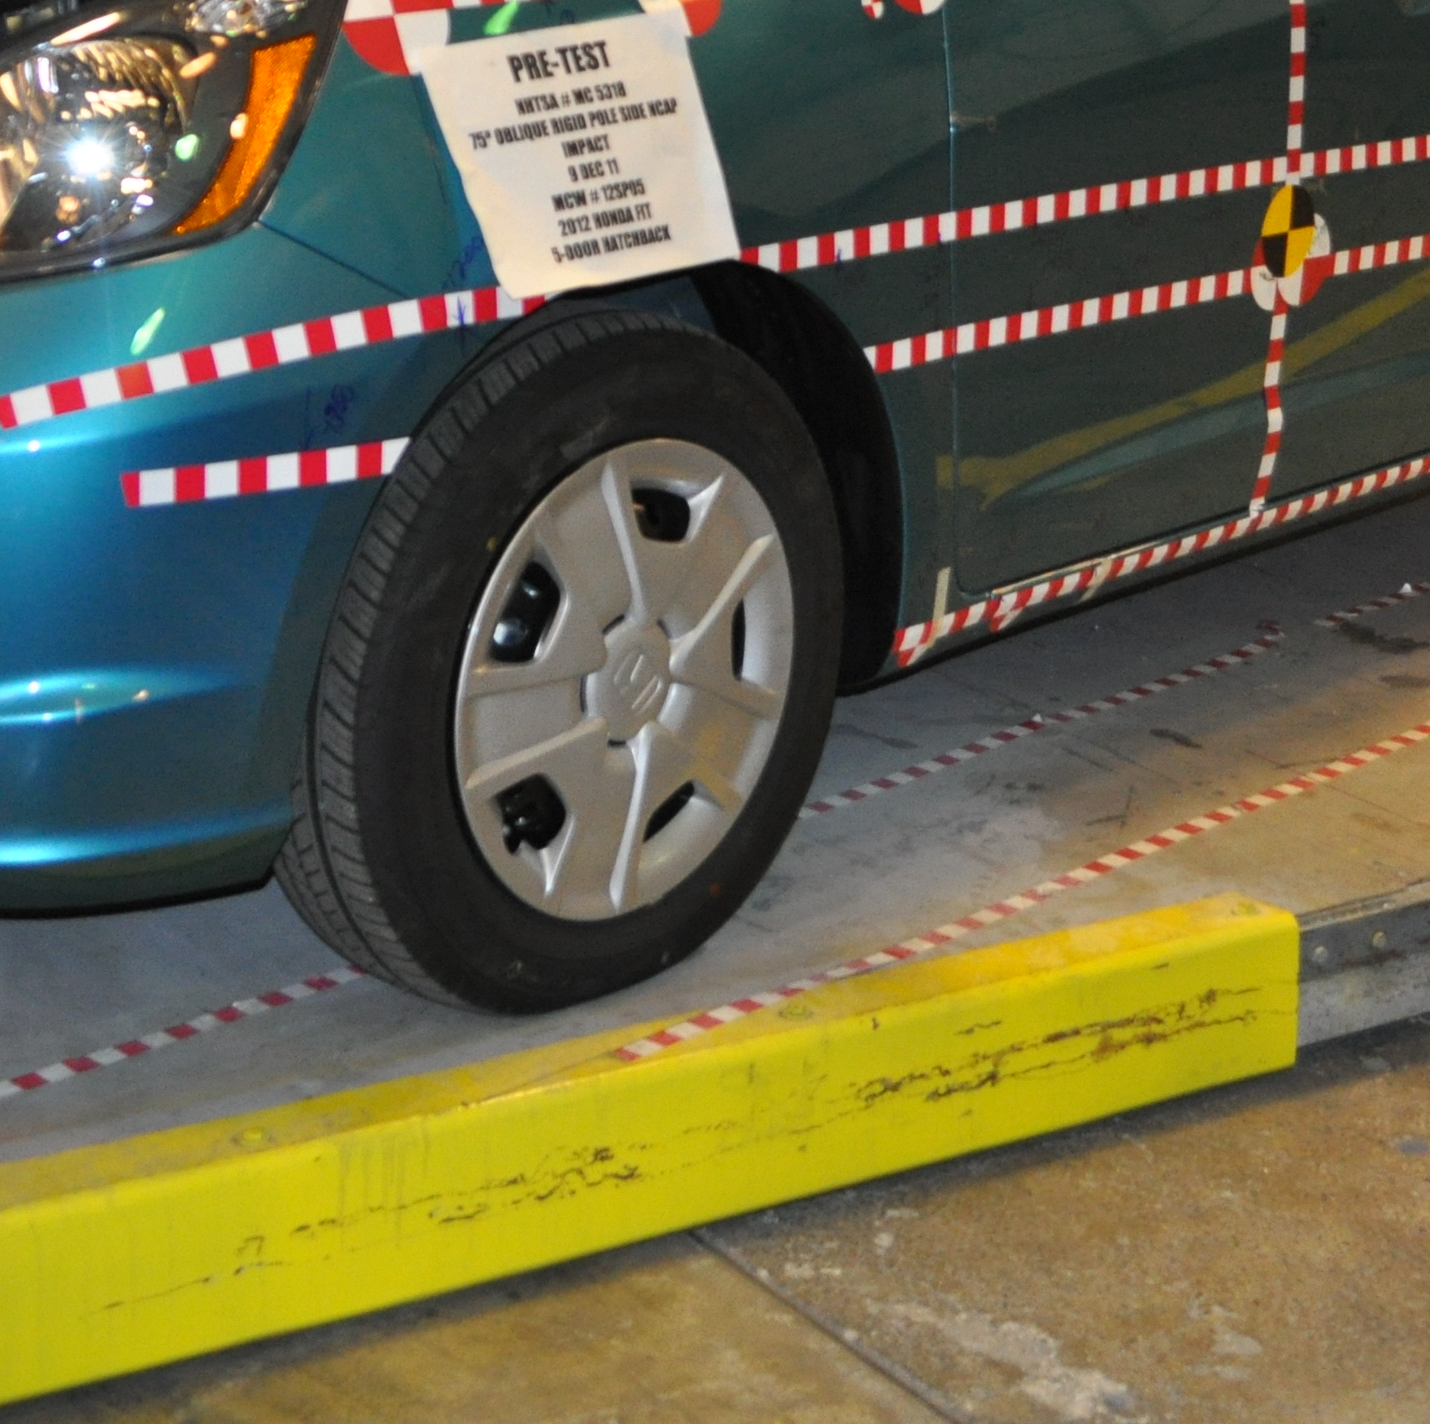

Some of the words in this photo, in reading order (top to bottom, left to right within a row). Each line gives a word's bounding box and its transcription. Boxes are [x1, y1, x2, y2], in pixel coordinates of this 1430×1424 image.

[506, 39, 611, 83] PRE-TEST
[515, 94, 559, 116] NHTSA
[561, 92, 571, 107] #
[572, 86, 594, 106] MC
[494, 120, 550, 146] OBLIQUE
[550, 113, 587, 136] RIGID
[588, 107, 619, 128] POLE
[619, 102, 647, 123] SIDE
[647, 97, 678, 117] NCAP
[561, 134, 611, 158] IMPACT
[579, 160, 605, 180] DEC
[605, 157, 620, 176] 11
[551, 189, 587, 212] MCW
[601, 178, 646, 202] 12SP05
[558, 214, 592, 237] 2012
[592, 206, 635, 230] HONDA
[634, 201, 652, 221] FIT
[550, 239, 602, 264] 5-DOOR
[601, 223, 672, 254] HATCHBACK
